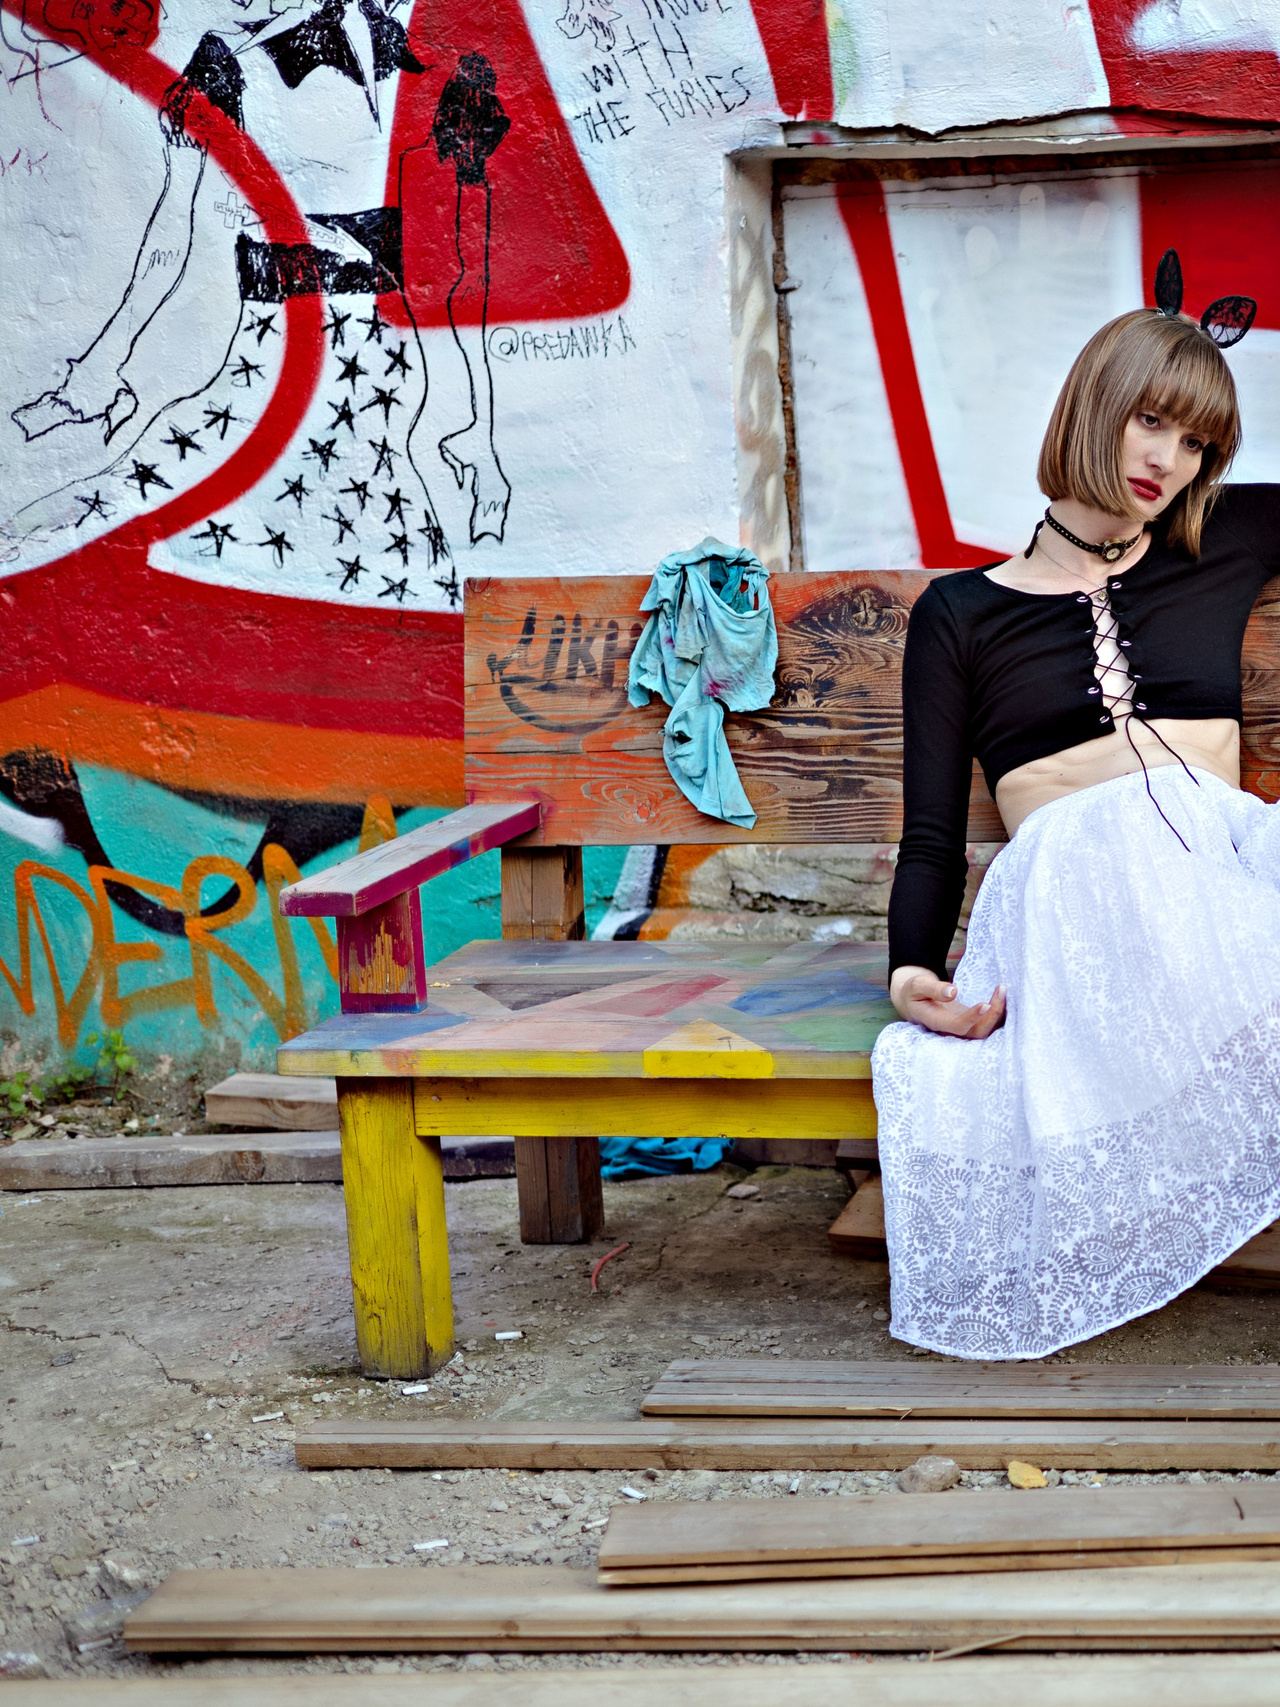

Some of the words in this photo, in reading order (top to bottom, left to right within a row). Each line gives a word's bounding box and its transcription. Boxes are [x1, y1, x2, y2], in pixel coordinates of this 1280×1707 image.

[582, 20, 693, 93] WITH
[573, 98, 636, 144] THE
[646, 66, 751, 126] FURIES
